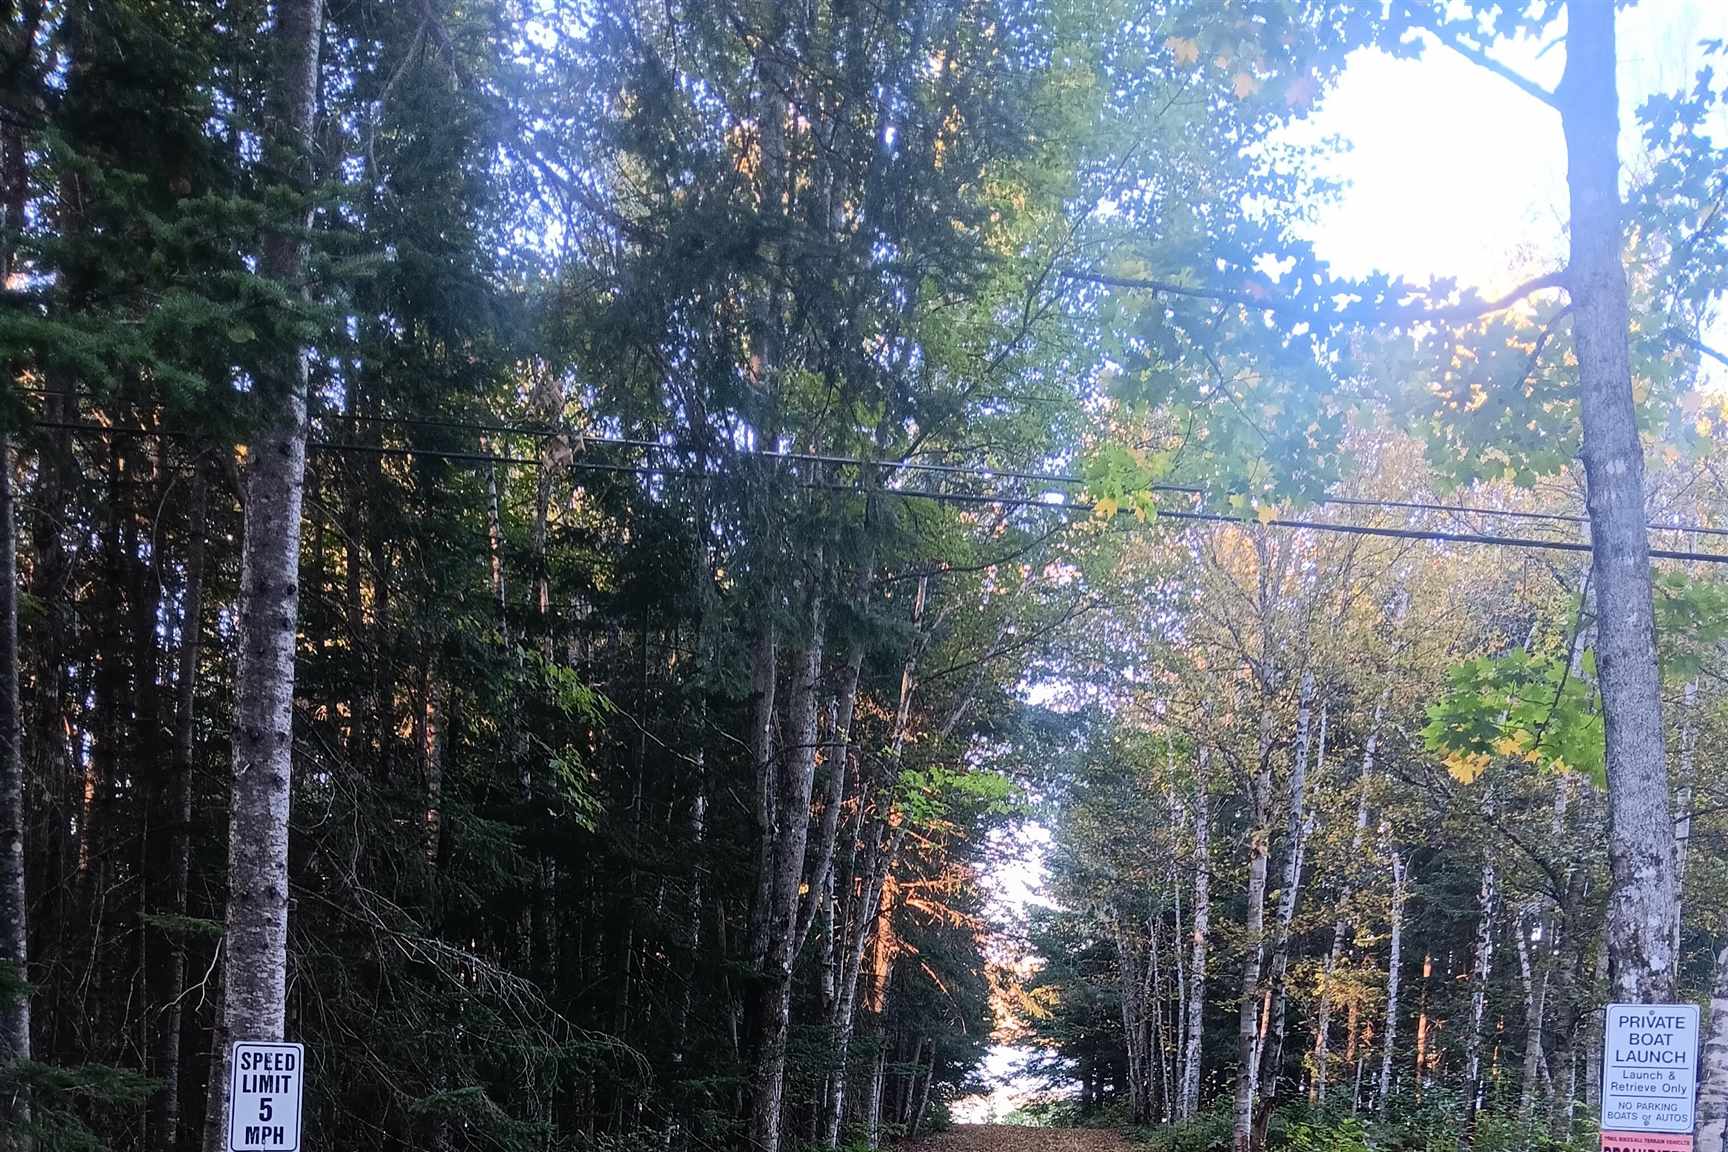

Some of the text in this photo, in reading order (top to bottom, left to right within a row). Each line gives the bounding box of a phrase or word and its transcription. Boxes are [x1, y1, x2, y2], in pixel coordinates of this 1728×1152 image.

[1619, 1015, 1686, 1029] PRIVATE
[1629, 1032, 1674, 1046] BOAT
[240, 1052, 295, 1071] SPEED
[1615, 1049, 1686, 1063] LAUNCH
[1622, 1069, 1676, 1080] Launch &
[242, 1074, 292, 1094] LIMIT
[1610, 1081, 1687, 1095] Retrieve Only
[259, 1097, 273, 1122] 5
[1618, 1101, 1678, 1112] NO PARKING
[1607, 1111, 1638, 1120] BOATS
[1655, 1113, 1689, 1122] AUTOS
[245, 1126, 284, 1145] MPH
